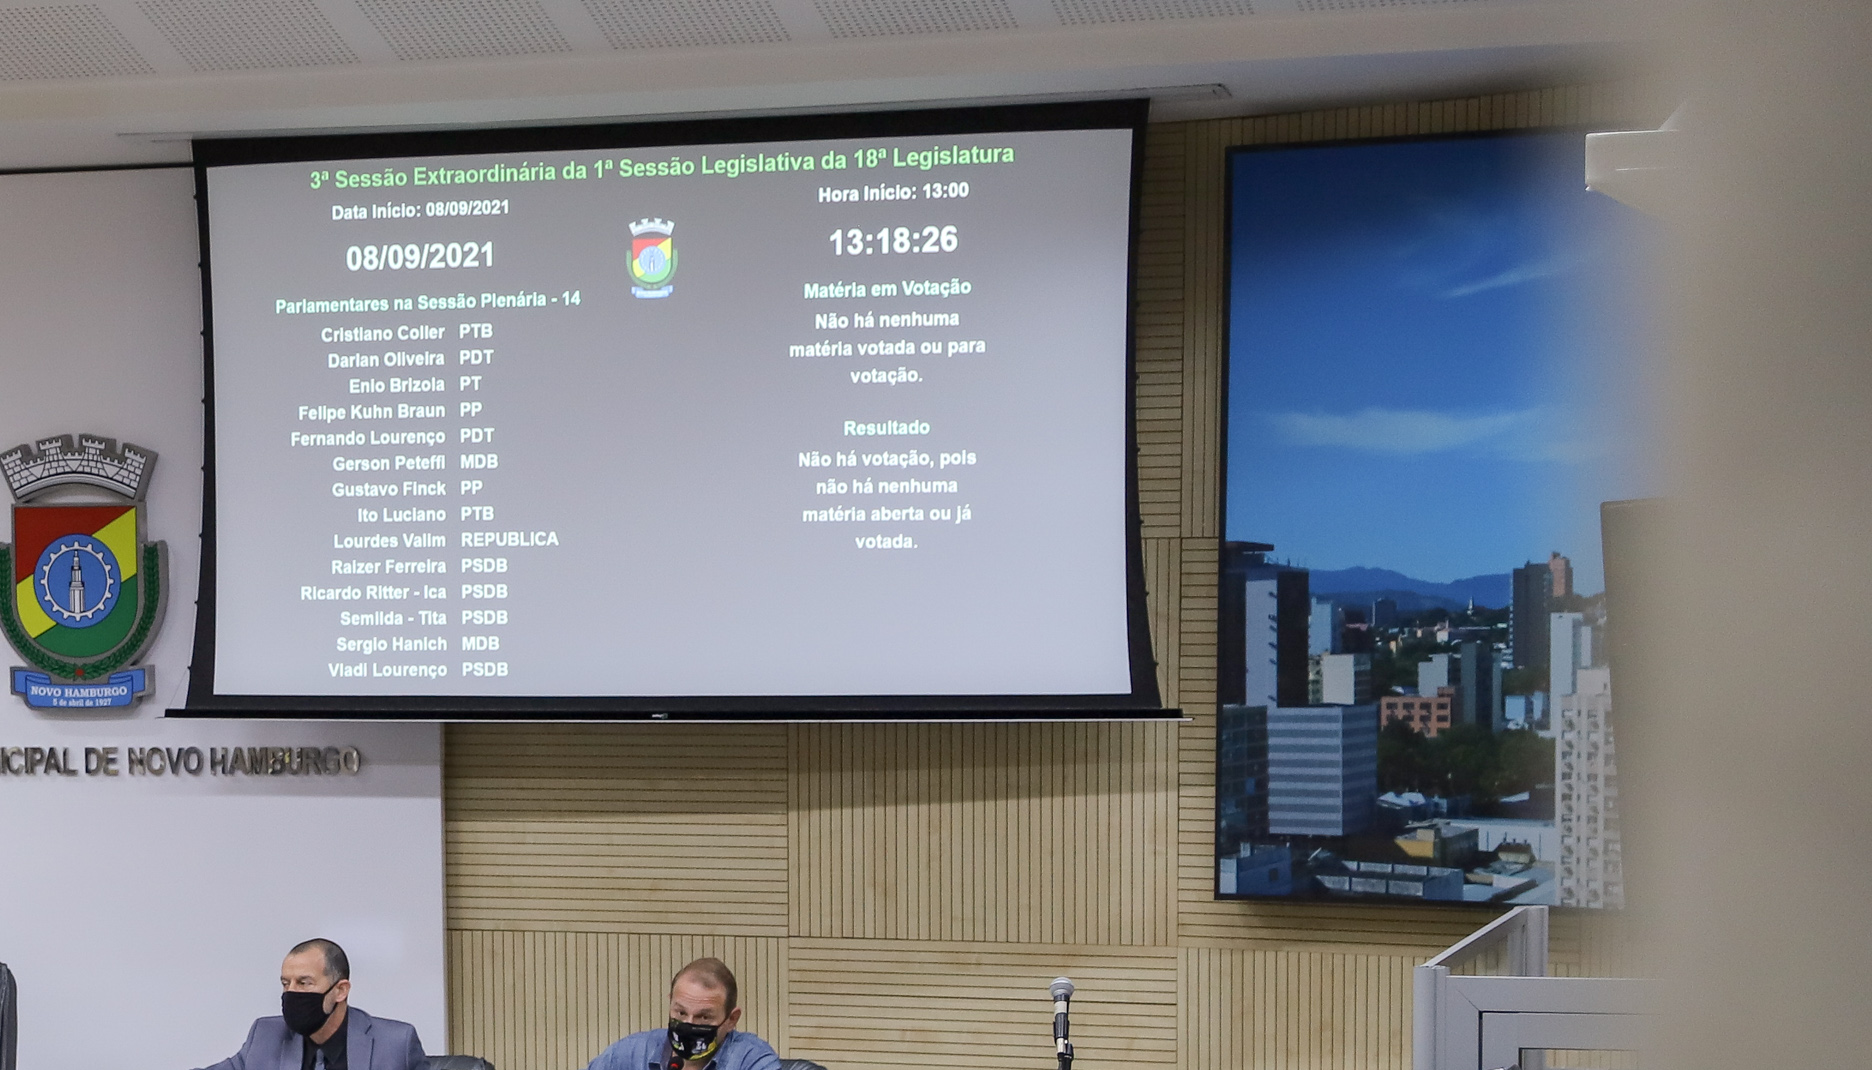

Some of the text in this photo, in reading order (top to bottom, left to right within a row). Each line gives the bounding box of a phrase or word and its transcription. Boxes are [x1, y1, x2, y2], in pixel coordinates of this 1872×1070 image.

[311, 145, 1014, 189] 3ª Sessão Extraordinária da 1ª Sessão Legislativa da 18ª Legislatura
[819, 182, 969, 202] Hora Início: 13:00
[332, 199, 508, 220] Data Início: 08/09/2021
[830, 225, 957, 255] 13:18:26
[347, 241, 492, 271] 08/09/2021
[804, 278, 971, 298] Matéria em Votação
[276, 298, 389, 314] Parlamentares
[394, 298, 412, 310] na
[418, 293, 476, 309] Sessão
[481, 291, 546, 308] Plenária
[562, 290, 581, 305] 14
[816, 311, 959, 329] Não há nenhuma
[321, 323, 493, 342] Cristiano Coller PTB
[790, 340, 985, 357] matéria votada ou para
[328, 349, 494, 368] Darlan Oliveira PDT
[350, 376, 482, 393] Enio Brizola PT
[851, 367, 922, 385] votação.
[299, 402, 482, 423] Felipe Kuhn Braun PP
[291, 428, 495, 446] Fernando Lourenço PDT
[844, 420, 930, 436] Resultado
[333, 454, 498, 471] Gerson Peteffi MDB
[799, 450, 976, 469] Não há votação, pois
[332, 480, 482, 497] Gustavo Finck PP
[817, 477, 957, 494] não há nenhuma
[358, 506, 494, 522] Ito Luciano PTB
[803, 504, 971, 524] matéria aberta ou já
[334, 531, 559, 548] Lourdes Valim REPUBLICA
[855, 534, 918, 548] votada.
[332, 558, 507, 574] Raizer Ferreira PSDB
[301, 586, 361, 600] Ricardo
[367, 585, 410, 599] Ritter
[424, 585, 446, 599] Ica
[462, 584, 508, 599] PSDB
[341, 611, 403, 625] Semilda
[418, 611, 447, 625] Tita
[462, 610, 508, 624] PSDB
[337, 636, 499, 654] Sergio Hanich MDB
[328, 662, 508, 679] Vladi Lourenço PSDB
[31, 686, 127, 698] NOVO HAMBURGO
[84, 746, 119, 776] DE
[127, 746, 203, 776] NOVO
[209, 746, 361, 776] HAMBURGO
